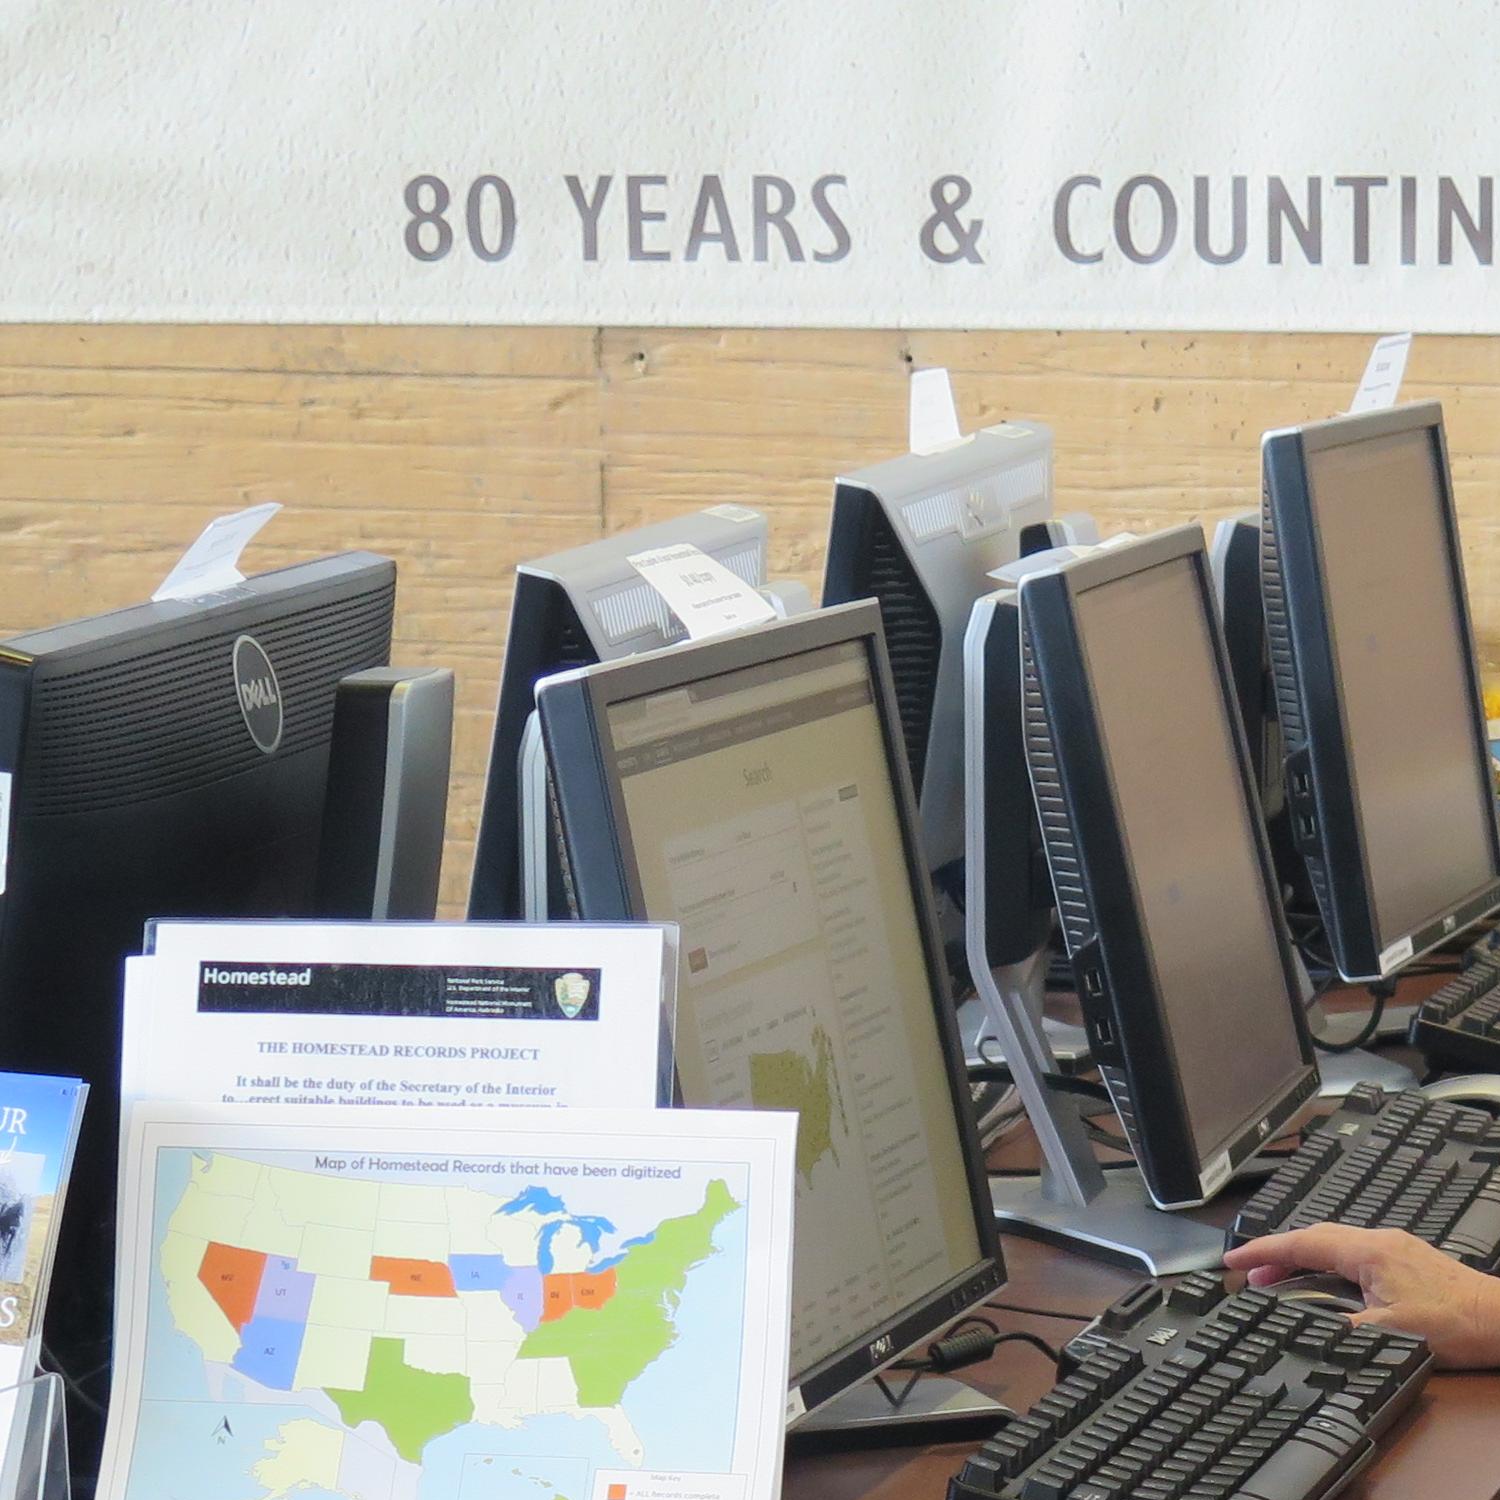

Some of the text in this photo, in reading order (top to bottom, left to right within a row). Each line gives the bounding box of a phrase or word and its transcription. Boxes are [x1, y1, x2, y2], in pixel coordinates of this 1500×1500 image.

[402, 174, 517, 263] 80
[563, 174, 851, 266] YEARS
[919, 174, 986, 266] &
[240, 677, 277, 711] DELL
[203, 968, 311, 986] Homestead
[257, 1041, 540, 1061] THE HOMESTEAD RECORDS PROJECT
[236, 1075, 557, 1096] It shall be the duty of the Secretary of the Interior
[314, 1156, 682, 1180] Map of Homestead Records that have been digitized
